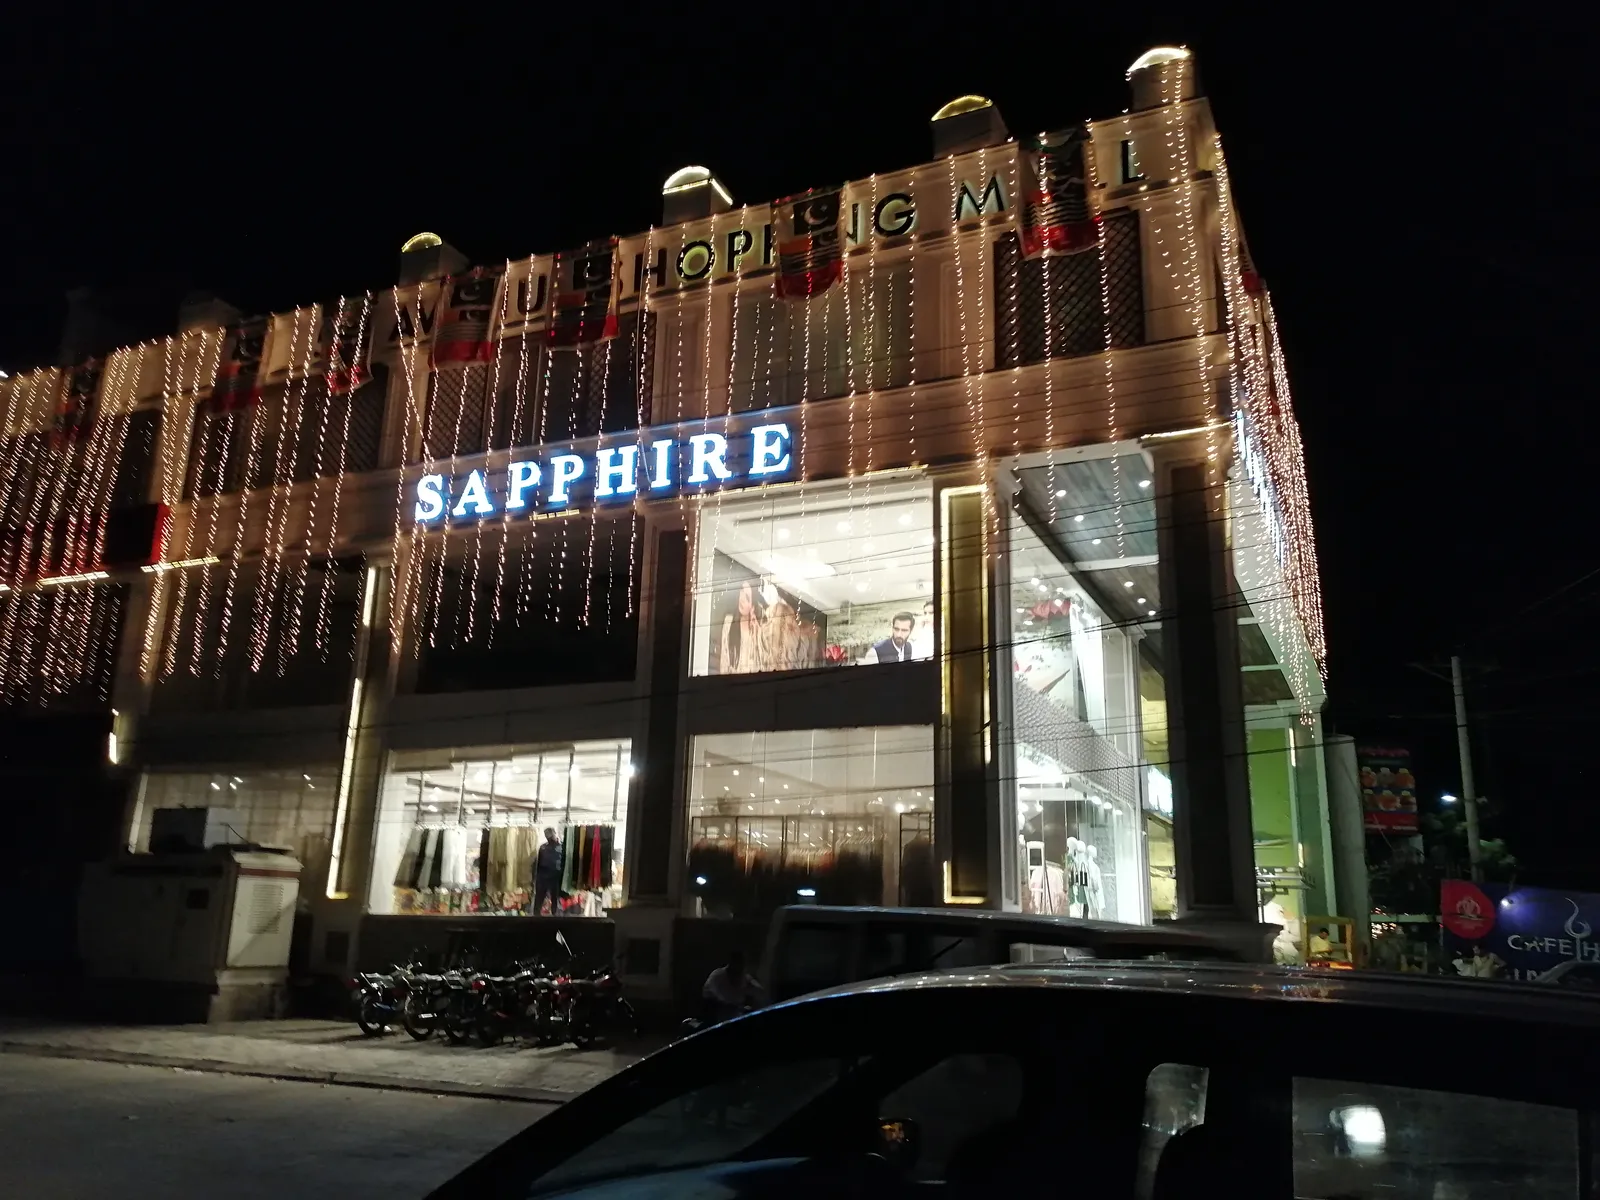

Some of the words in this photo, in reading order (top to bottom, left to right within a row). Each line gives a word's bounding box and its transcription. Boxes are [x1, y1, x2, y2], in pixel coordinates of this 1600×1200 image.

[954, 139, 1146, 222] ML
[415, 423, 791, 521] SAPPHIRE
[1507, 934, 1574, 956] CAFE
